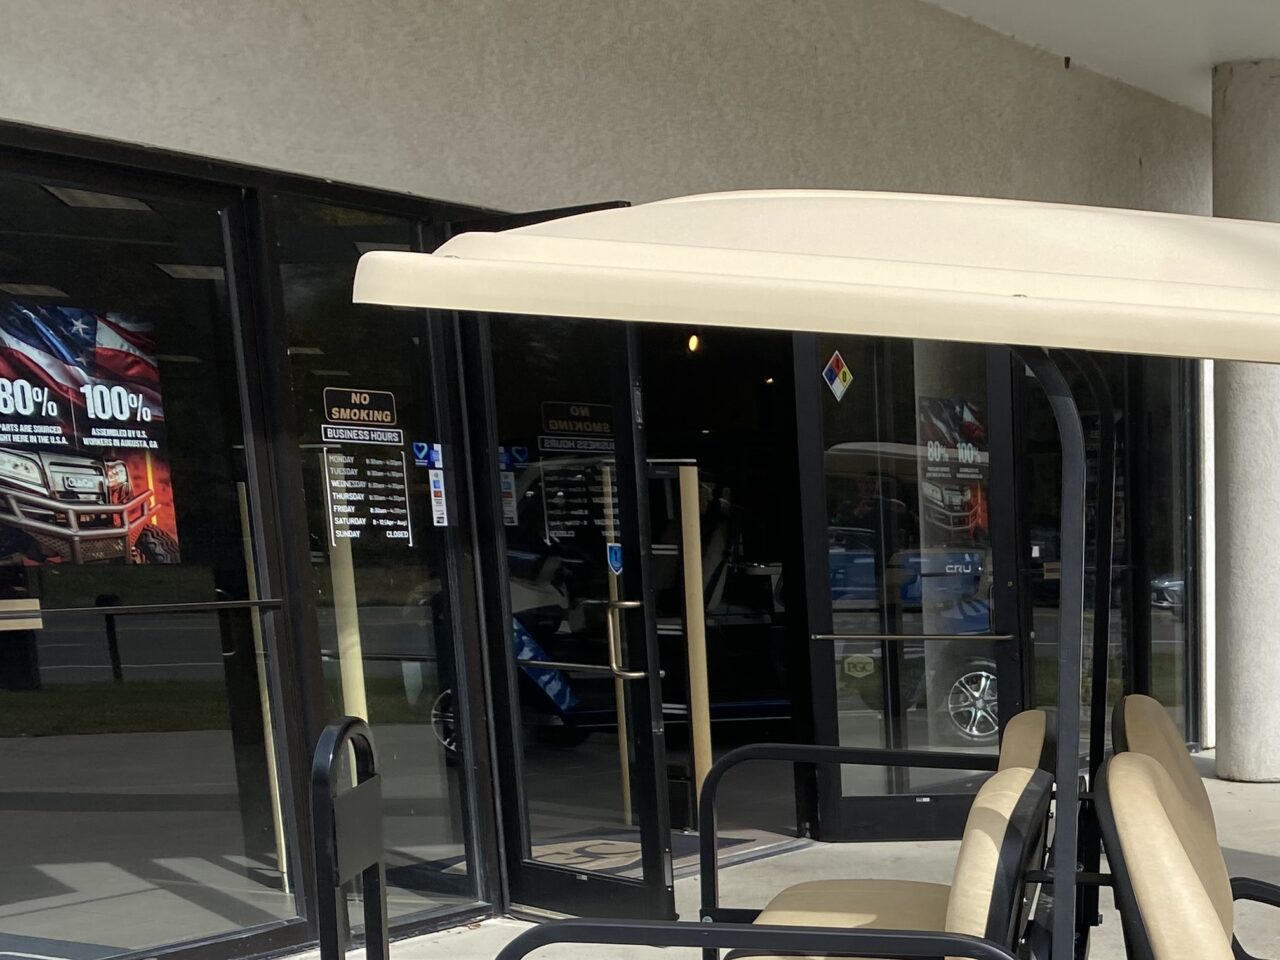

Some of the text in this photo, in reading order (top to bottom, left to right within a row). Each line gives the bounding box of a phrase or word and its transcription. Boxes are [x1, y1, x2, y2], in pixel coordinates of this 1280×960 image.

[0, 377, 58, 416] 80%
[351, 393, 369, 405] NO
[80, 384, 152, 422] 100%
[331, 407, 391, 422] SMOKING
[19, 424, 33, 433] ARE
[33, 425, 62, 434] SOURCED
[91, 427, 148, 438] ASSEMBLED BY U.S.
[12, 434, 30, 443] HERE
[30, 434, 37, 443] IN
[37, 435, 50, 444] THE
[327, 428, 399, 442] BUSINESS HOURS
[82, 437, 113, 446] WORKERS
[112, 438, 120, 447] IN
[149, 440, 158, 449] GA
[927, 440, 981, 464] 80% 100%
[328, 455, 354, 463] MONDAY
[330, 467, 358, 475] TUESDAY
[331, 479, 367, 488] WEDNESDAY
[332, 492, 365, 500] THURSDAY
[333, 505, 356, 513] FRIDAY
[334, 517, 366, 525] SATURDAY
[335, 530, 361, 538] SUNDAY
[945, 564, 972, 573] CRU
